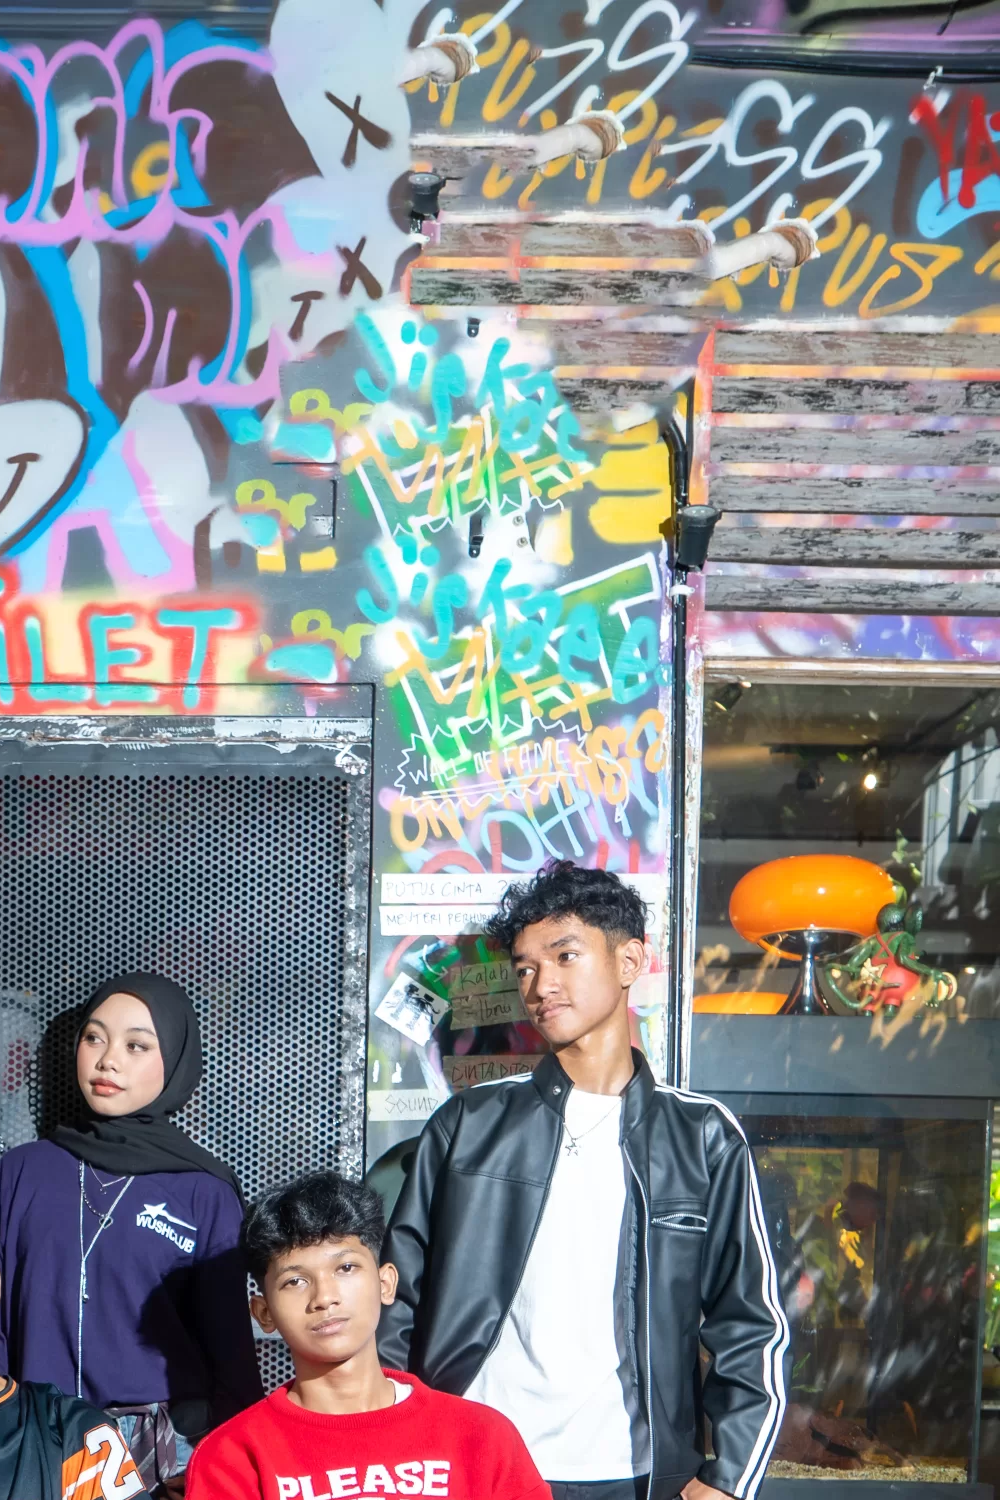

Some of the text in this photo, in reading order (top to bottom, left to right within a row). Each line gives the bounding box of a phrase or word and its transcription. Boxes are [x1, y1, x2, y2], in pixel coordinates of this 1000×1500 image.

[409, 738, 570, 786] WALL OF FAME
[386, 881, 435, 897] PUTUS
[441, 881, 483, 897] CINTA
